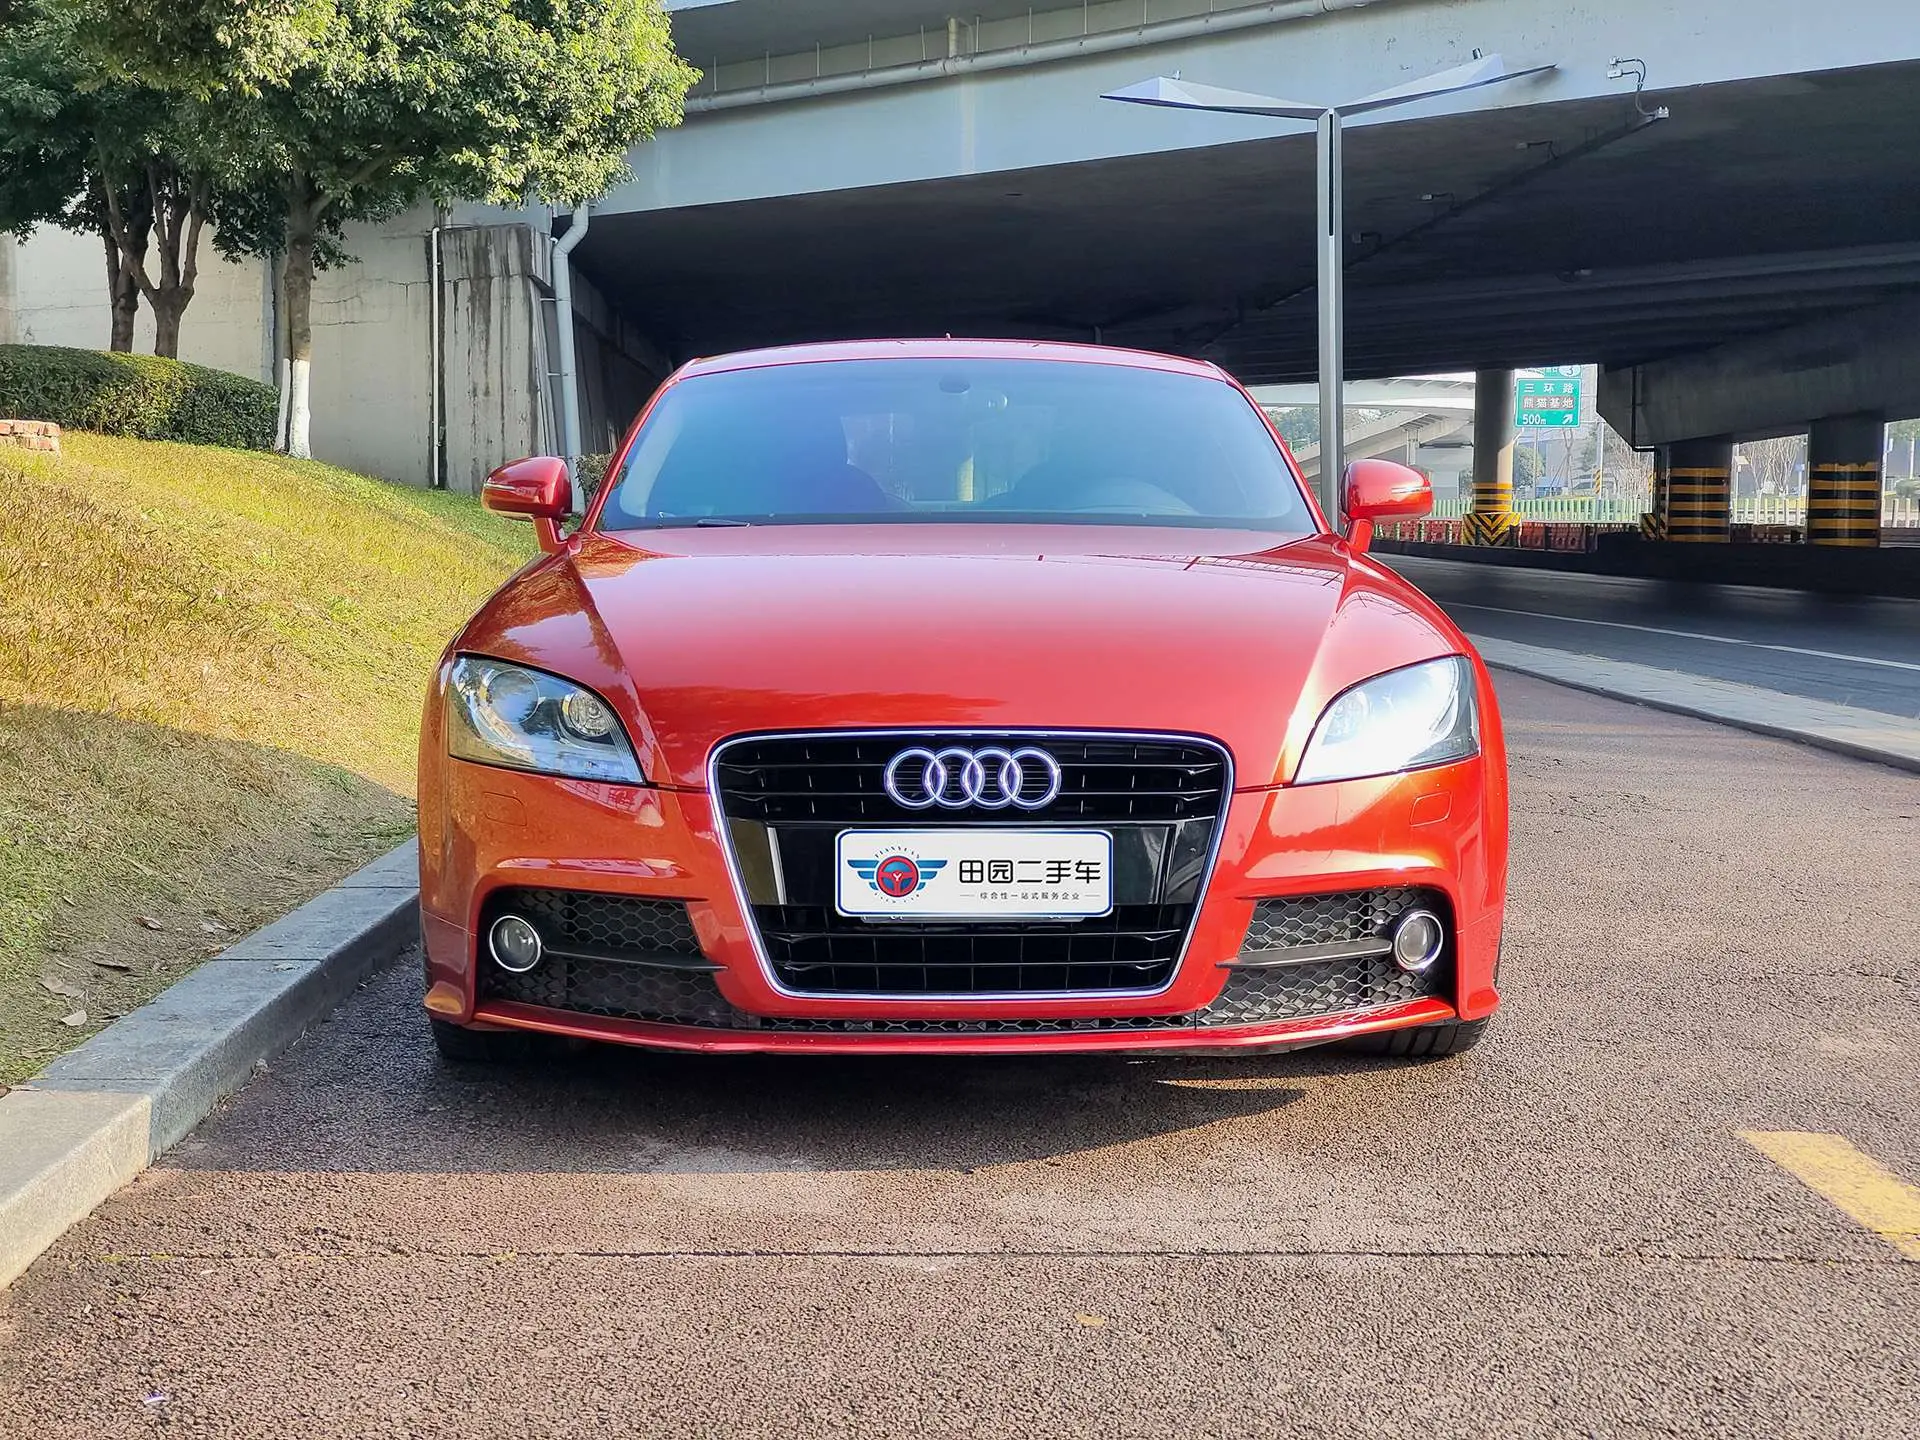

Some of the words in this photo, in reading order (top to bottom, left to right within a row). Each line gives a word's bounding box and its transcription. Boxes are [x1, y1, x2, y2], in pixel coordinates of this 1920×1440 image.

[1524, 383, 1574, 393] 三环路
[1524, 397, 1574, 408] 熊猫基地
[1523, 414, 1546, 424] 500m
[959, 859, 1101, 884] 田园二手车
[979, 891, 1080, 900] 综合性一站式服务企业
